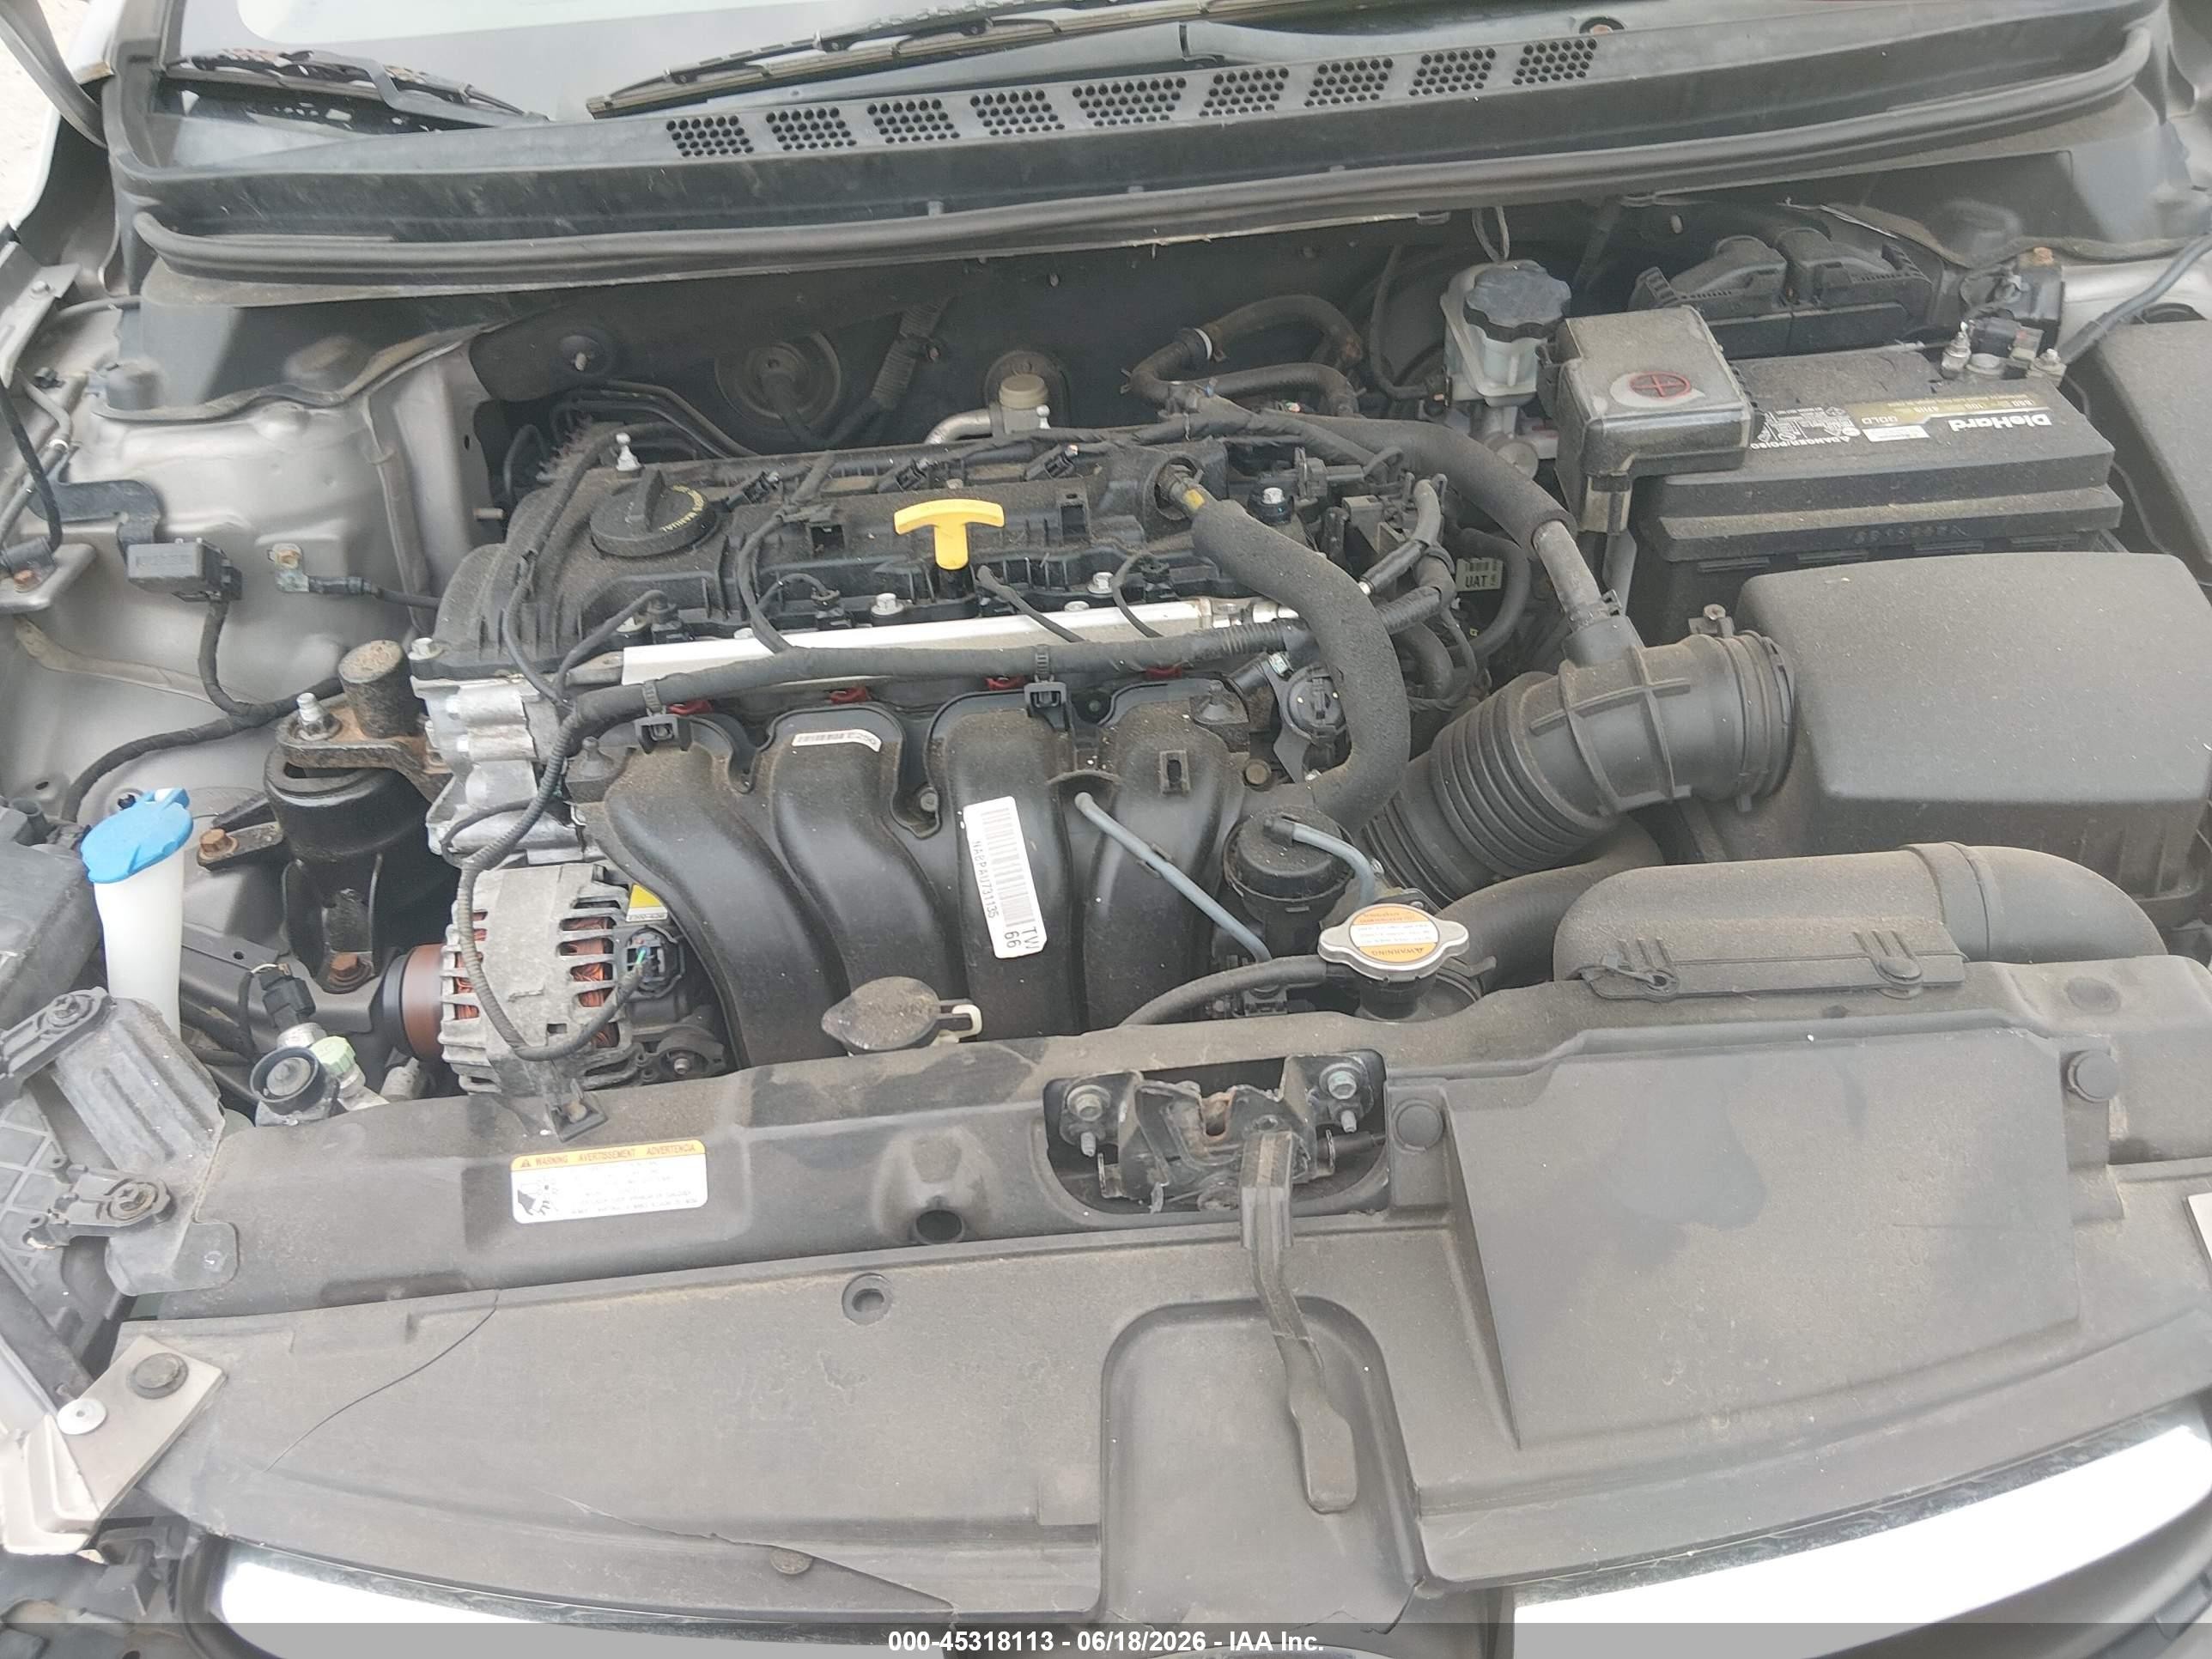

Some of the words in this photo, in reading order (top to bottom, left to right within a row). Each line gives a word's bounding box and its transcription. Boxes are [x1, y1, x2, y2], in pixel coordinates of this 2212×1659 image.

[1948, 413, 2052, 432] DieHard
[1750, 436, 1842, 449] DANGER/POISO
[1465, 575, 1488, 588] UAT
[1004, 930, 1022, 949] 66
